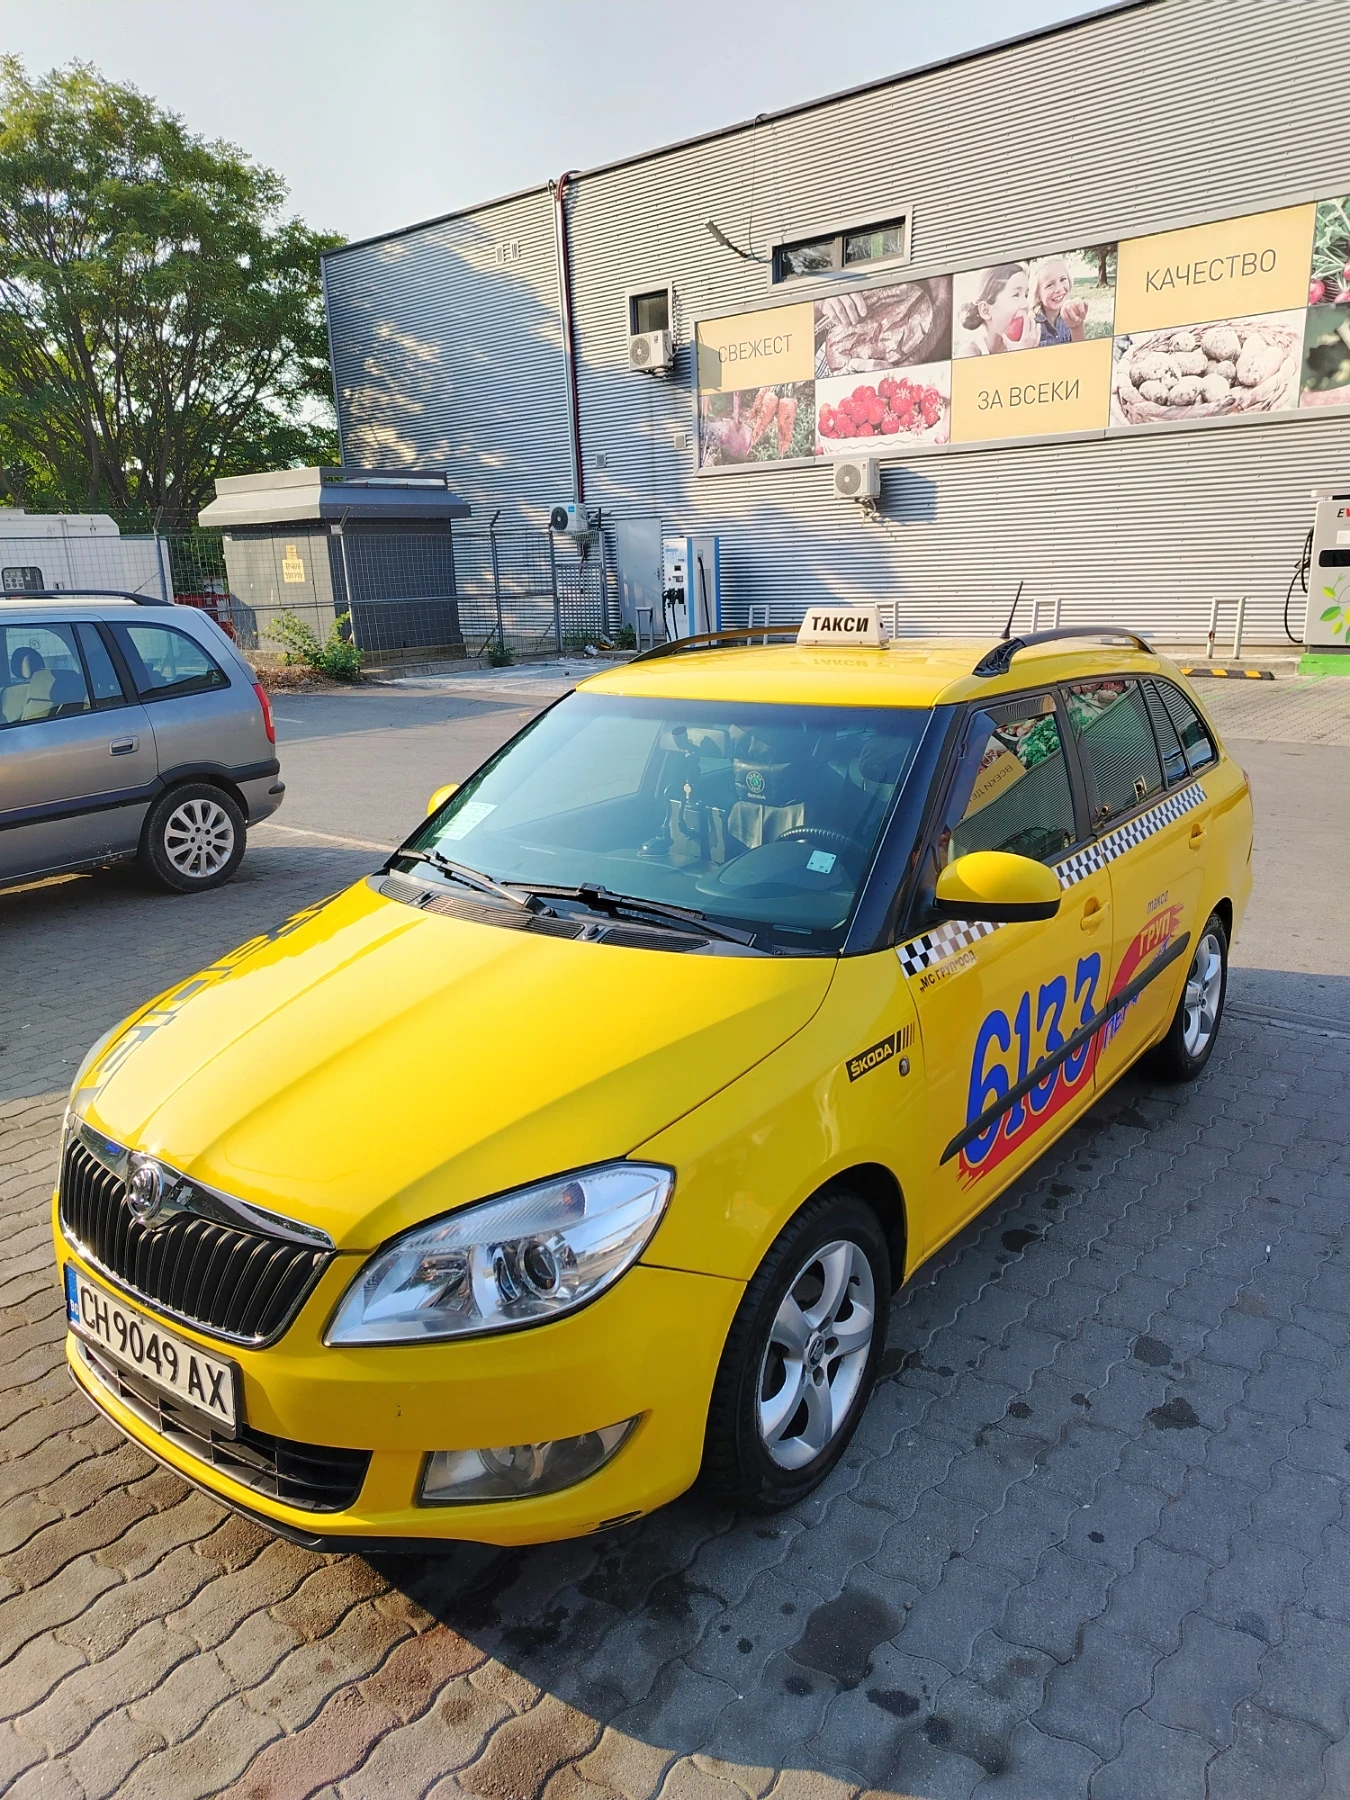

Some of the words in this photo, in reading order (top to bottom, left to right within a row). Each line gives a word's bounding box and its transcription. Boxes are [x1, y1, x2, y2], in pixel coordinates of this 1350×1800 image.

[1145, 248, 1277, 293] КАЧЕСТВО
[718, 333, 793, 364] СВЕЖЕСТ
[977, 389, 1003, 411] ЗА
[1009, 379, 1080, 406] ВСЕКИ
[811, 616, 869, 632] ТАКСИ
[1138, 910, 1172, 957] ГРУП
[850, 1043, 893, 1077] ŠKODA
[962, 951, 1102, 1166] 6133
[80, 1284, 112, 1343] CH
[113, 1310, 179, 1386] 9049
[187, 1355, 229, 1415] AX
